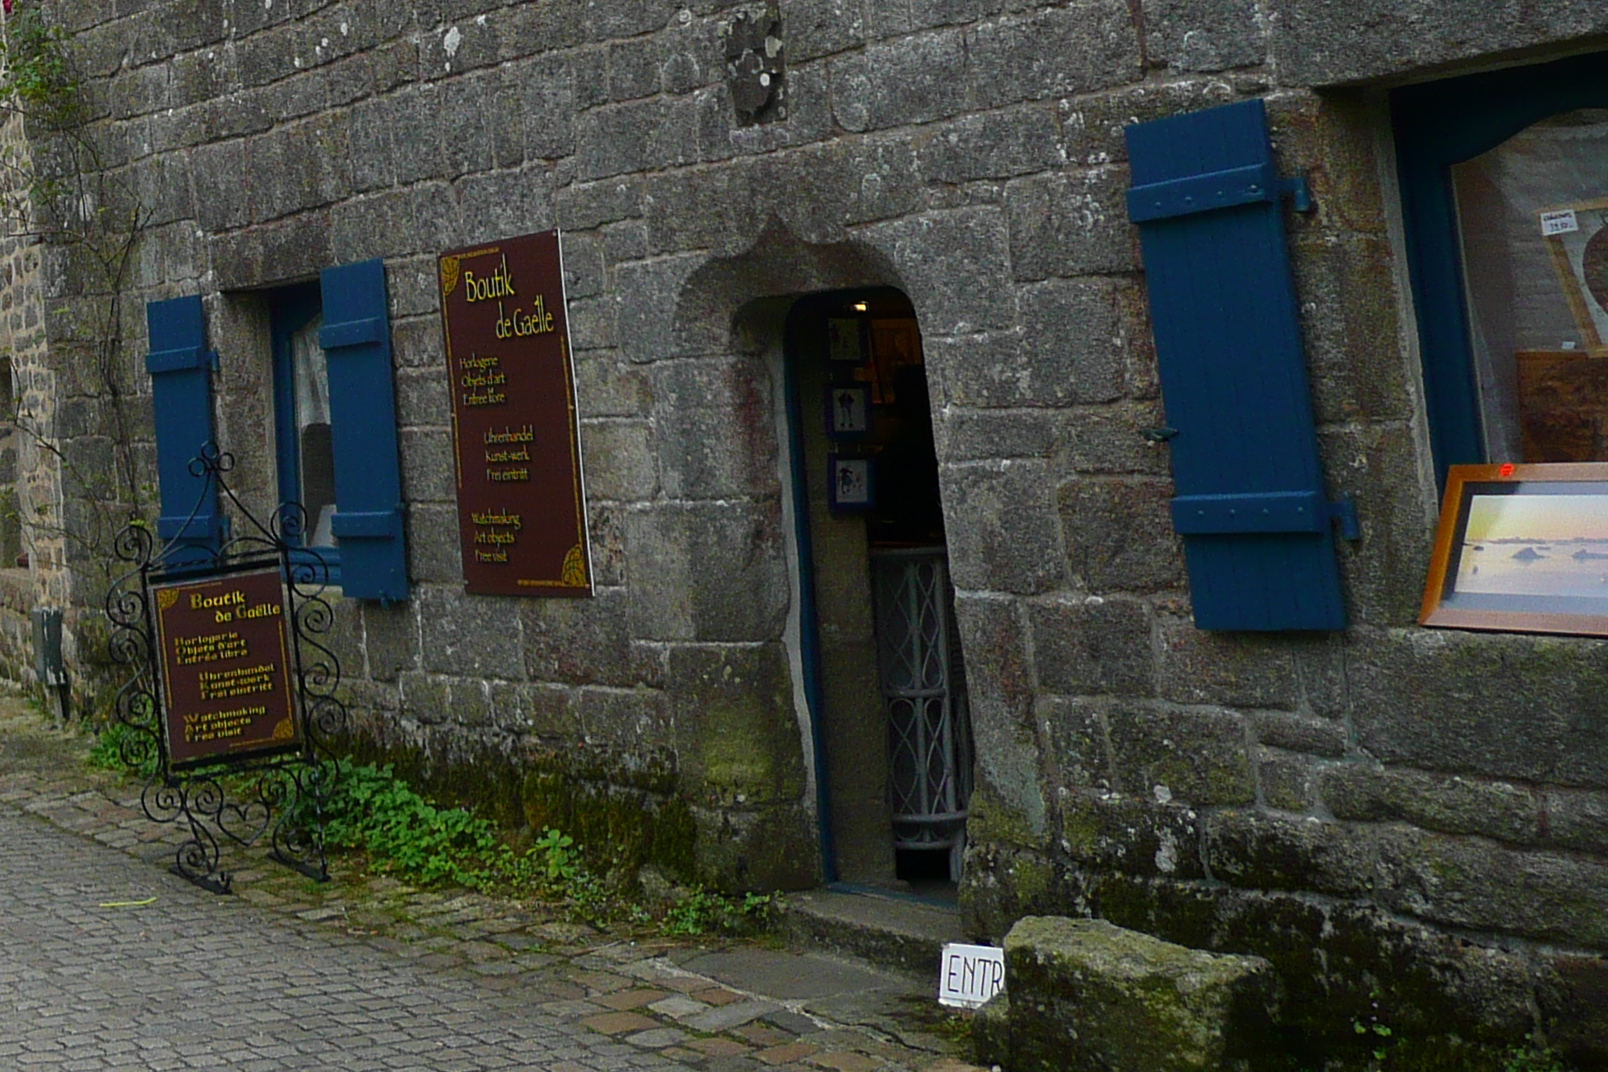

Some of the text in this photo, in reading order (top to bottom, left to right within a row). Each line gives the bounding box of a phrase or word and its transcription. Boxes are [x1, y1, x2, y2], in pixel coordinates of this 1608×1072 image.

[464, 253, 515, 302] Boutik
[496, 294, 555, 339] de Gaëlle
[459, 353, 498, 373] Horlogerie
[472, 508, 521, 530] Watchmaking
[191, 591, 245, 610] Boutik
[215, 602, 281, 623] de Gaëlle
[174, 632, 239, 647] Horlogerie
[176, 645, 215, 656] Objets
[220, 648, 248, 659] libre
[199, 663, 275, 681] Uhrenhandel
[184, 706, 266, 724] Watchmaking
[185, 717, 252, 734] Art objects
